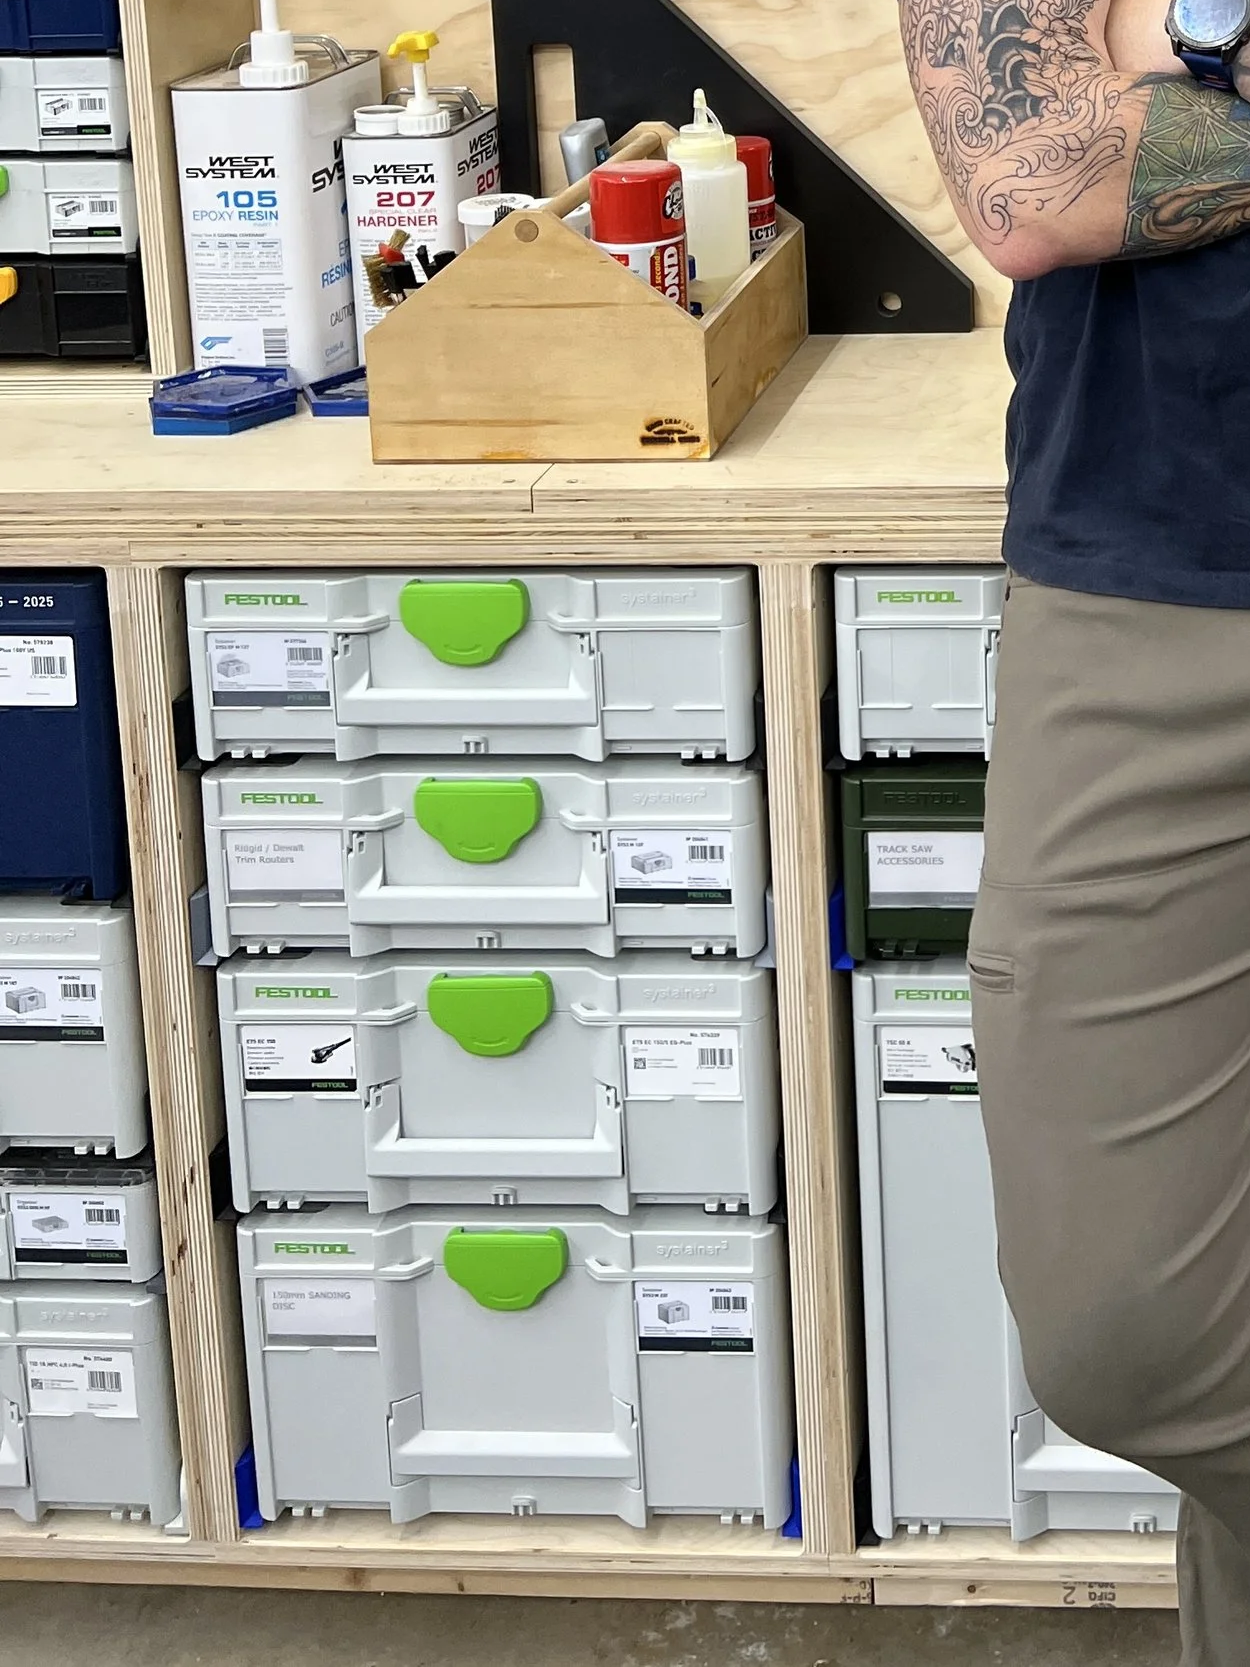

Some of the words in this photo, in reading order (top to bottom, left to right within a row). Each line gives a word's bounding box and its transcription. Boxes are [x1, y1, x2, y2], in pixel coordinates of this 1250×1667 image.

[209, 156, 274, 167] WEST
[186, 168, 276, 179] SYSTEM
[374, 163, 433, 174] WEST
[353, 175, 435, 185] SYSTEM
[477, 166, 501, 194] 207
[216, 191, 278, 208] 105
[376, 191, 435, 207] 207
[193, 210, 234, 222] EPOXY
[238, 210, 279, 221] RESIN
[357, 216, 438, 227] HARDENER
[664, 246, 680, 303] OND
[330, 302, 354, 327] CAUTIO
[23, 596, 54, 608] 2025
[224, 594, 308, 605] FESTOOL
[878, 591, 962, 603] FESTOOL
[241, 793, 323, 804] FESTOOL
[273, 844, 304, 852] Dewalt
[877, 845, 908, 853] TRACK
[911, 845, 933, 853] SAW
[877, 857, 944, 865] ACCESSORIES
[255, 987, 338, 998] FESTOOL
[274, 1243, 356, 1254] FESTOOL
[308, 1291, 351, 1301] SANDING
[272, 1302, 296, 1310] DISC
